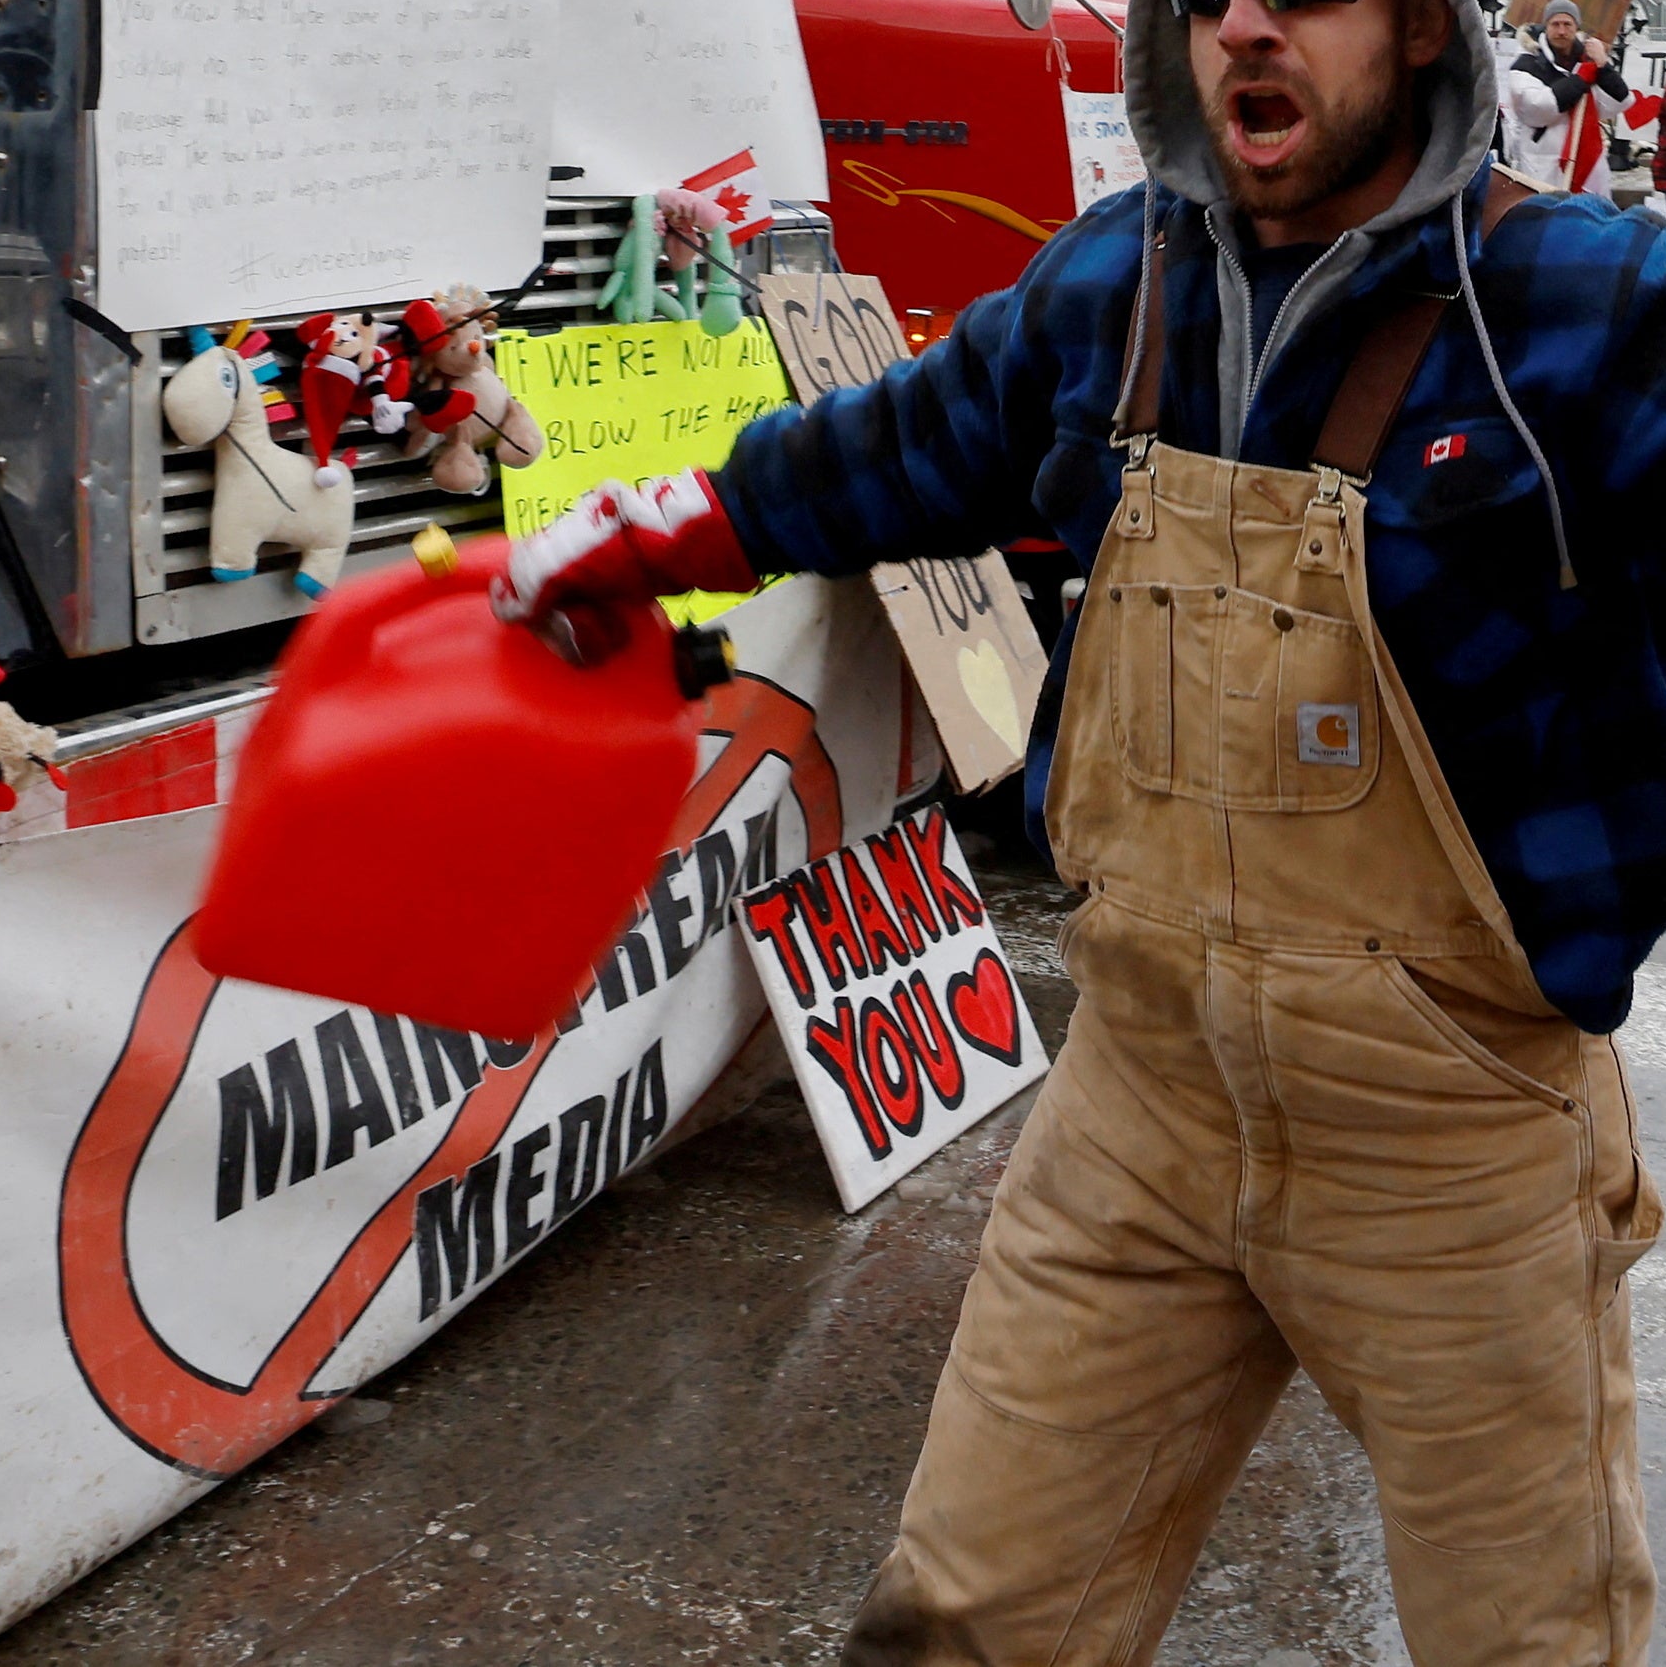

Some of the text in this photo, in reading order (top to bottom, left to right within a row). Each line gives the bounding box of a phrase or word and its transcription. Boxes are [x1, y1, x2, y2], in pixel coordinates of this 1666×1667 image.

[203, 54, 228, 76] no
[282, 43, 309, 68] the
[116, 110, 185, 136] message
[246, 103, 272, 136] you
[545, 334, 657, 388] WE'RE
[683, 335, 721, 372] NOT
[786, 298, 902, 395] GOD
[545, 418, 636, 459] BLOW
[660, 405, 709, 442] THE
[742, 803, 986, 1008] THANK
[808, 970, 960, 1160] YOU
[413, 1038, 668, 1323] MEDIA
